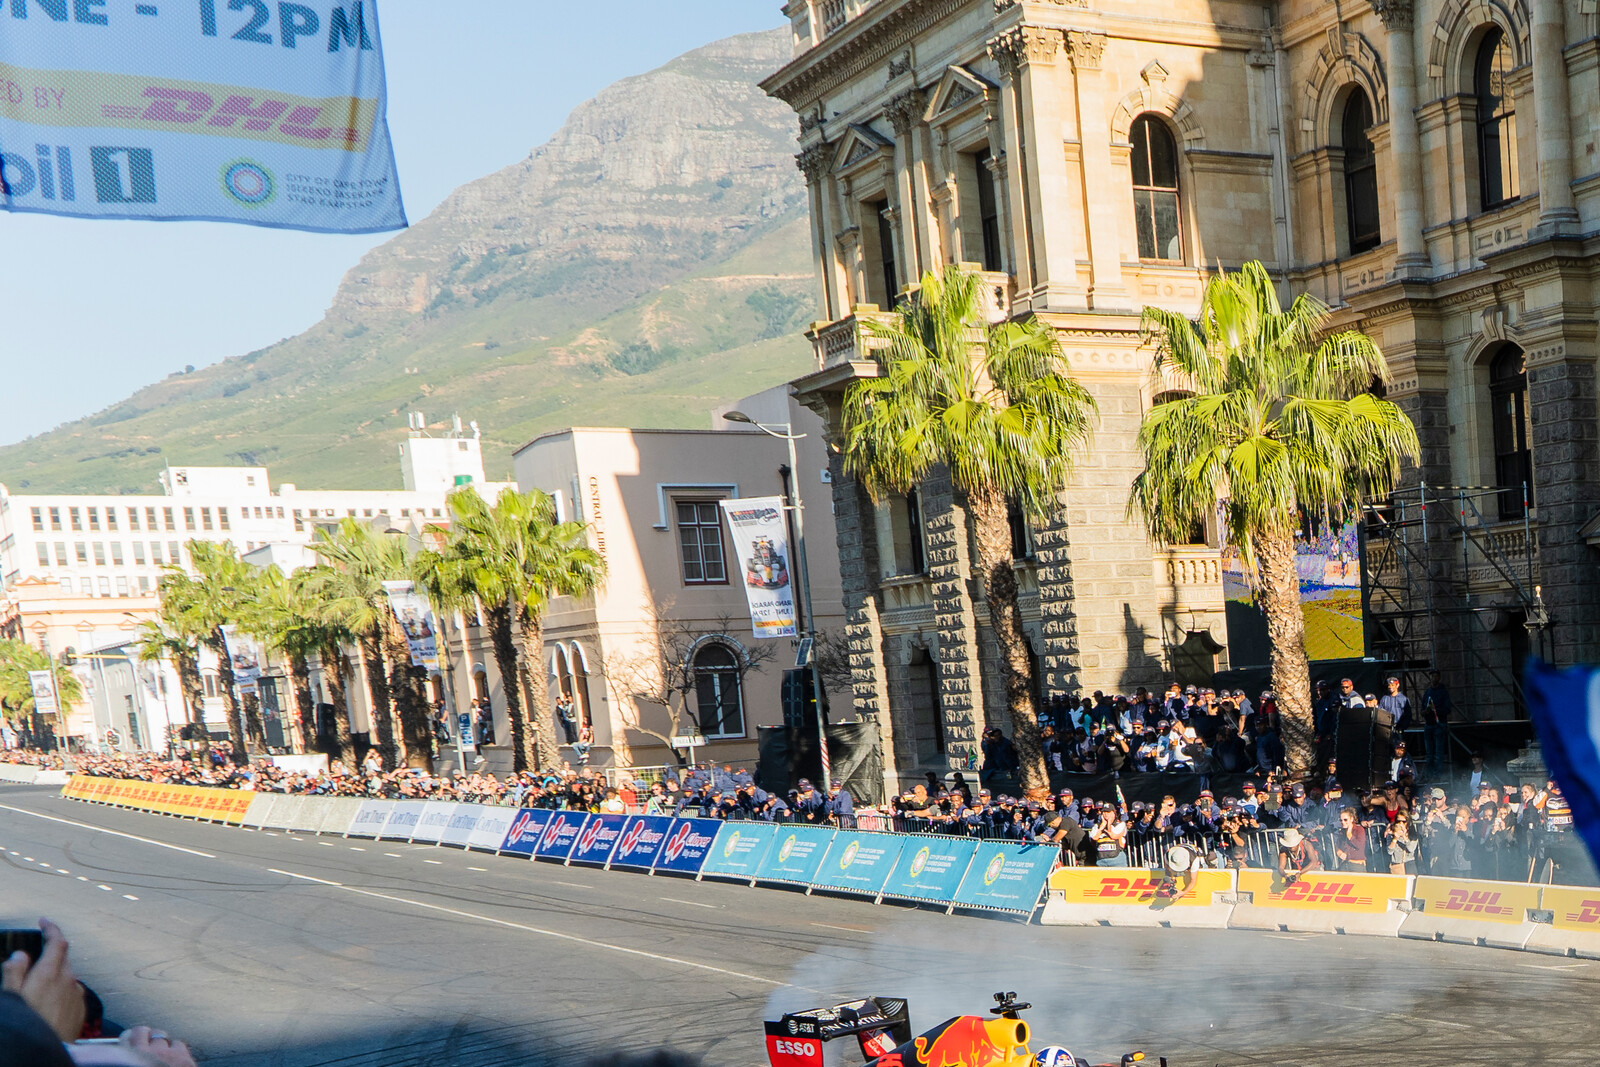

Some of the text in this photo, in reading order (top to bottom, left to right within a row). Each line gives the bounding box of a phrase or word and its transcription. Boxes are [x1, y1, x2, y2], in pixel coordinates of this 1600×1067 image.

[199, 0, 373, 52] 12PM
[34, 86, 65, 110] BY
[140, 86, 333, 139] DHL
[589, 476, 602, 522] CENTRAL
[685, 832, 712, 848] Clover
[1282, 881, 1358, 904] DHL
[1445, 889, 1502, 914] DHL
[776, 1040, 815, 1057] ESSO
